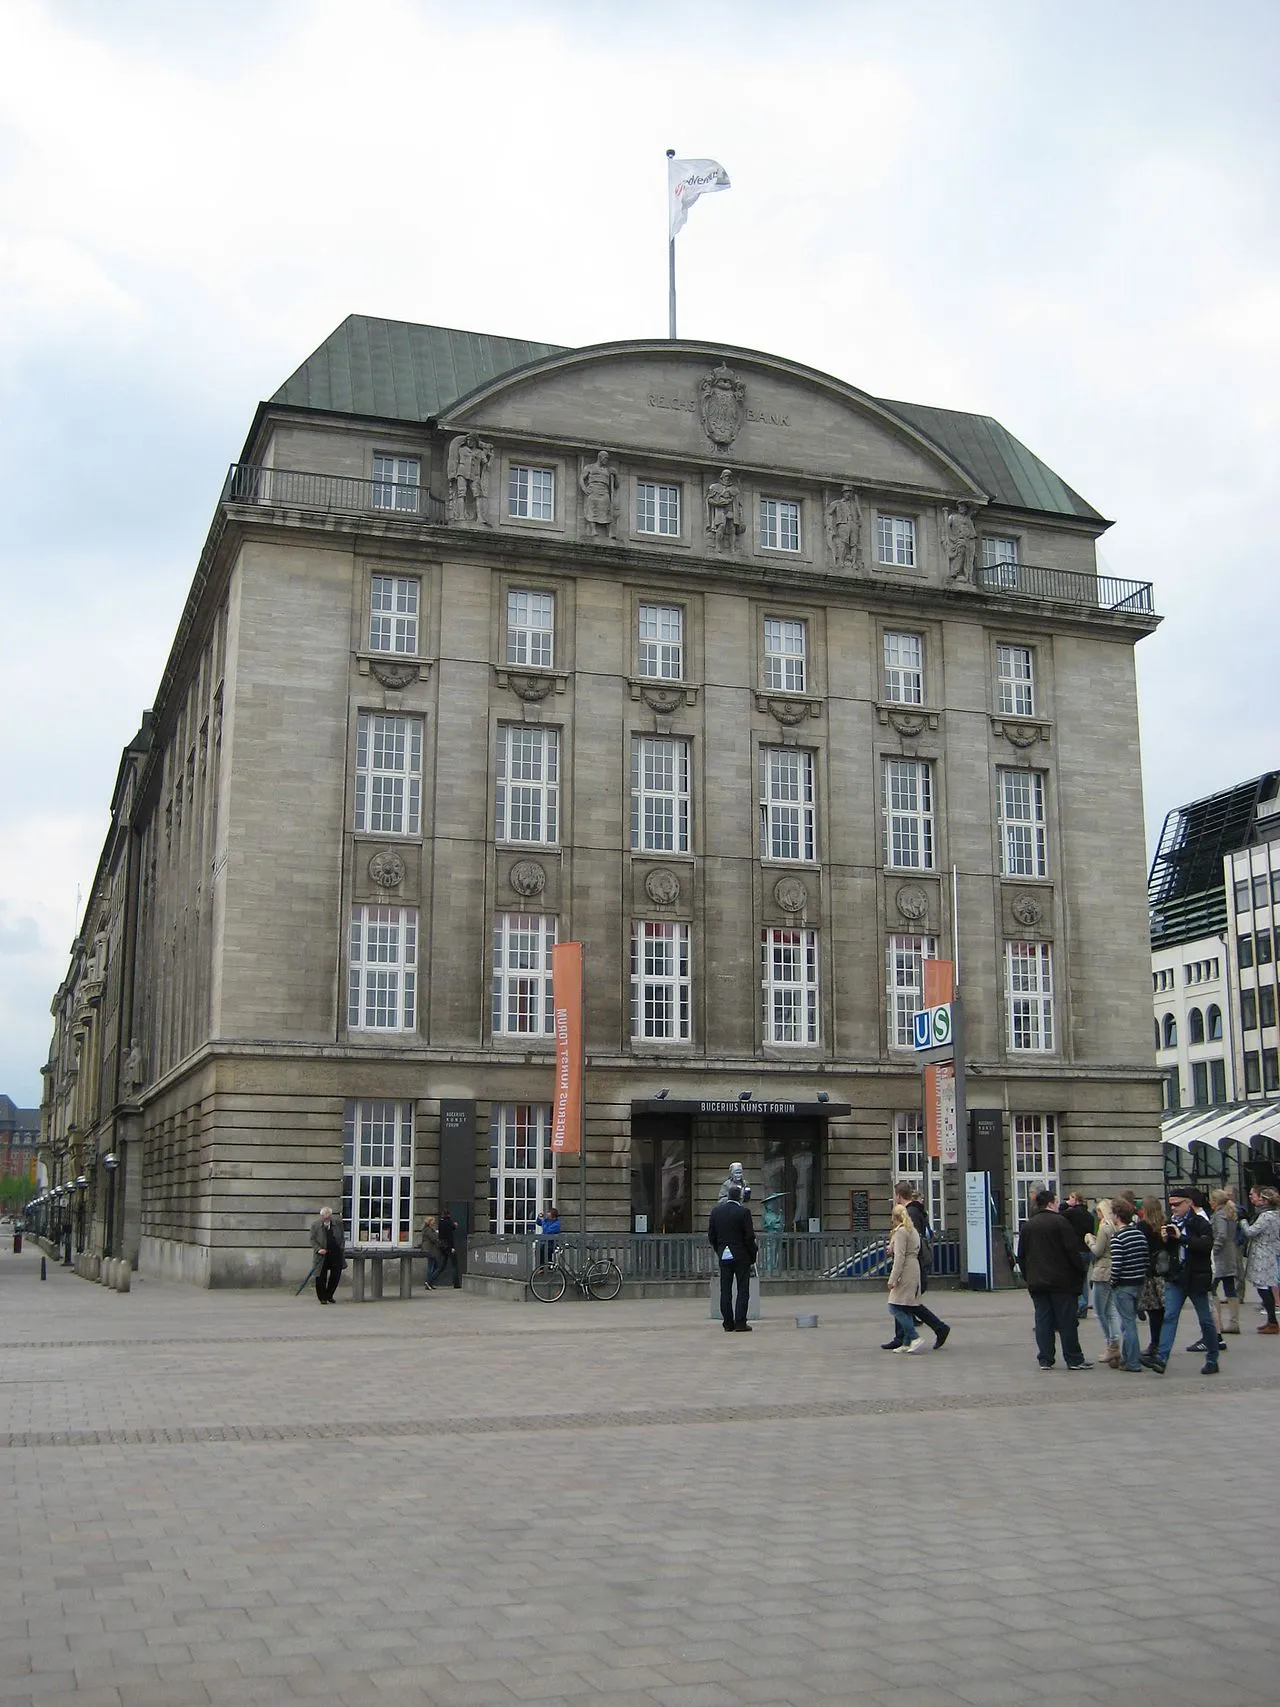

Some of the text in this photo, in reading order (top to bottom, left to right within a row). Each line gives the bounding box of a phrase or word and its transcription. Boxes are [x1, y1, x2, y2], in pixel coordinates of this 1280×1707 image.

[916, 1008, 949, 1044] U S
[701, 1102, 795, 1113] BUCERIUS KUNST FORUM
